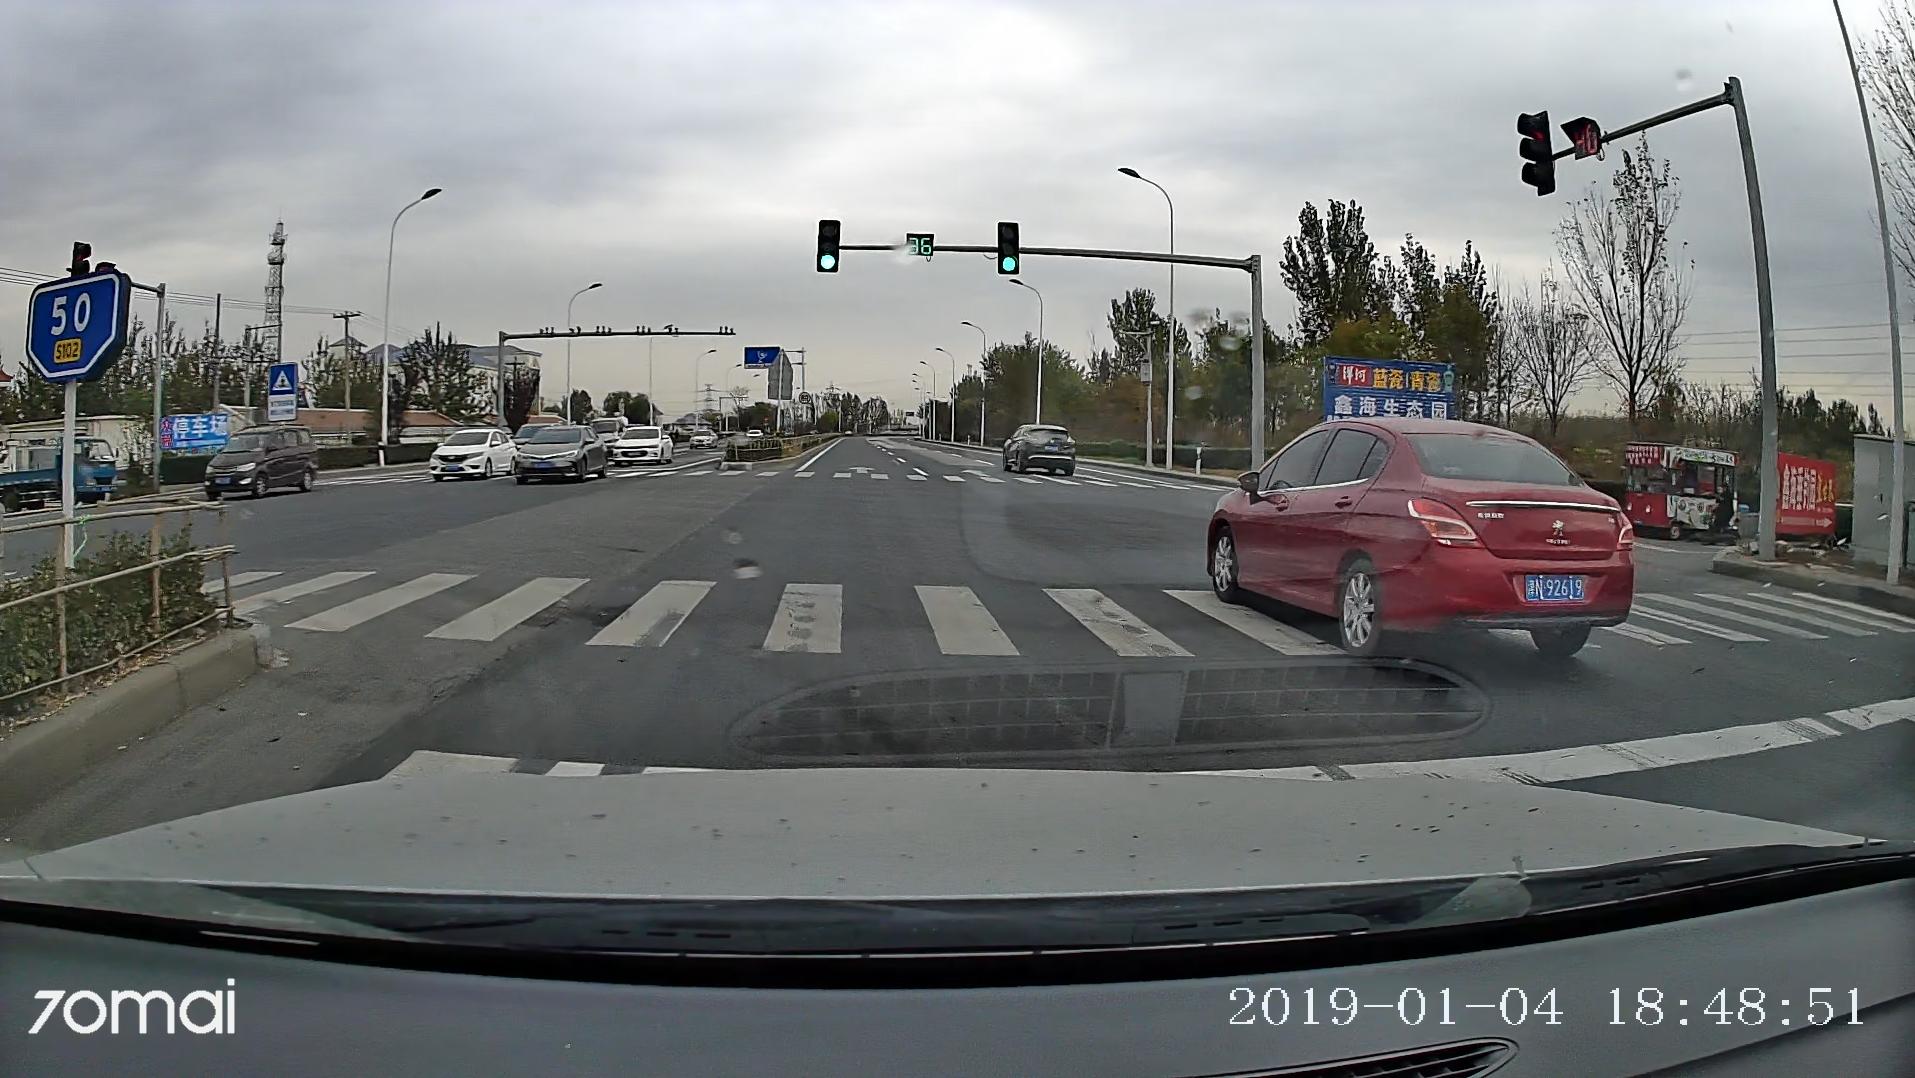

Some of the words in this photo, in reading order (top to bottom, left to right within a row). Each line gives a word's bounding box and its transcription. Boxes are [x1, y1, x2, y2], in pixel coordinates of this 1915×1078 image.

[908, 237, 932, 255] 36
[51, 292, 91, 335] 50
[55, 342, 80, 360] S102
[1334, 394, 1448, 420] 鑫海生态园
[172, 414, 229, 440] 停车场
